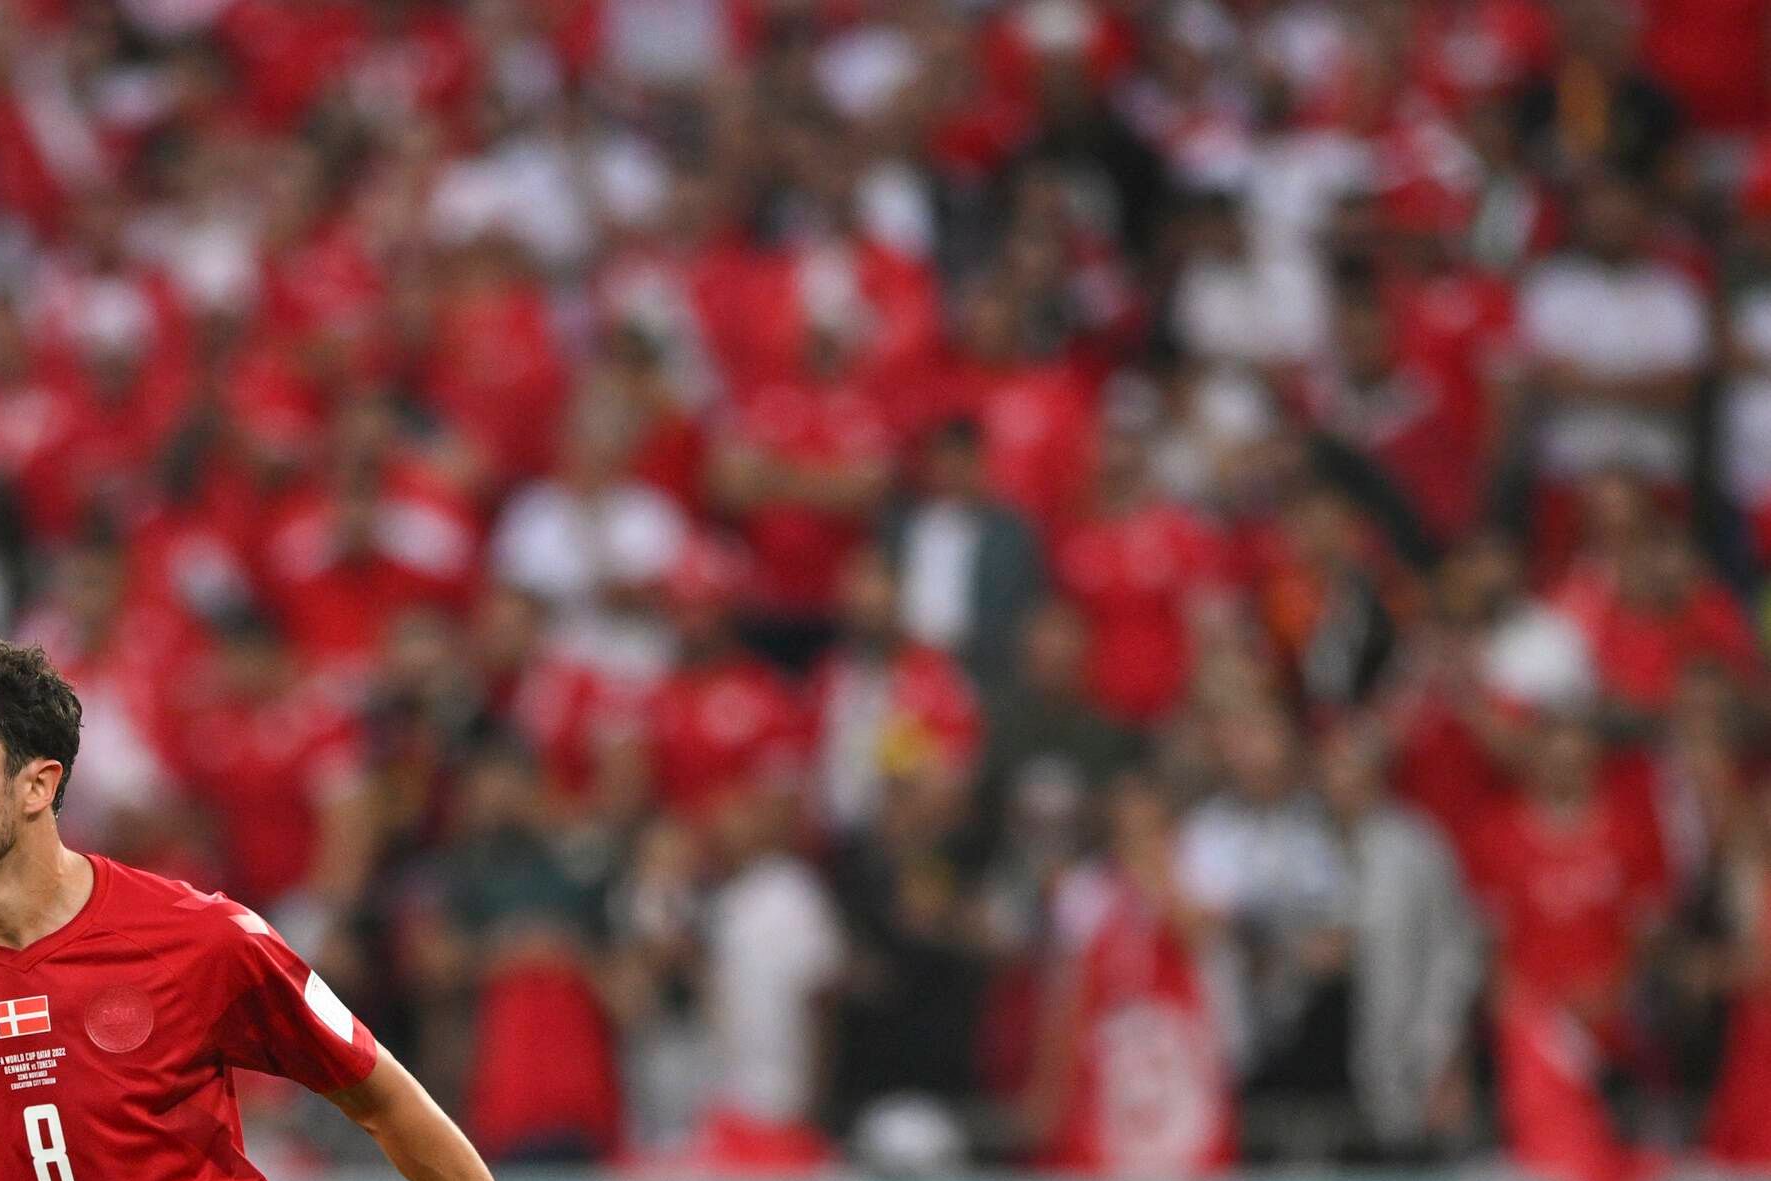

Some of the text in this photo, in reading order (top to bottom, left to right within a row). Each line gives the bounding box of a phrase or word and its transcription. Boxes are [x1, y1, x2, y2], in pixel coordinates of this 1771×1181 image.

[4, 1053, 25, 1064] WORLD
[25, 1051, 36, 1061] CUP
[36, 1049, 51, 1060] QATAR
[51, 1048, 66, 1057] 2022
[4, 1063, 31, 1075] DENMARK
